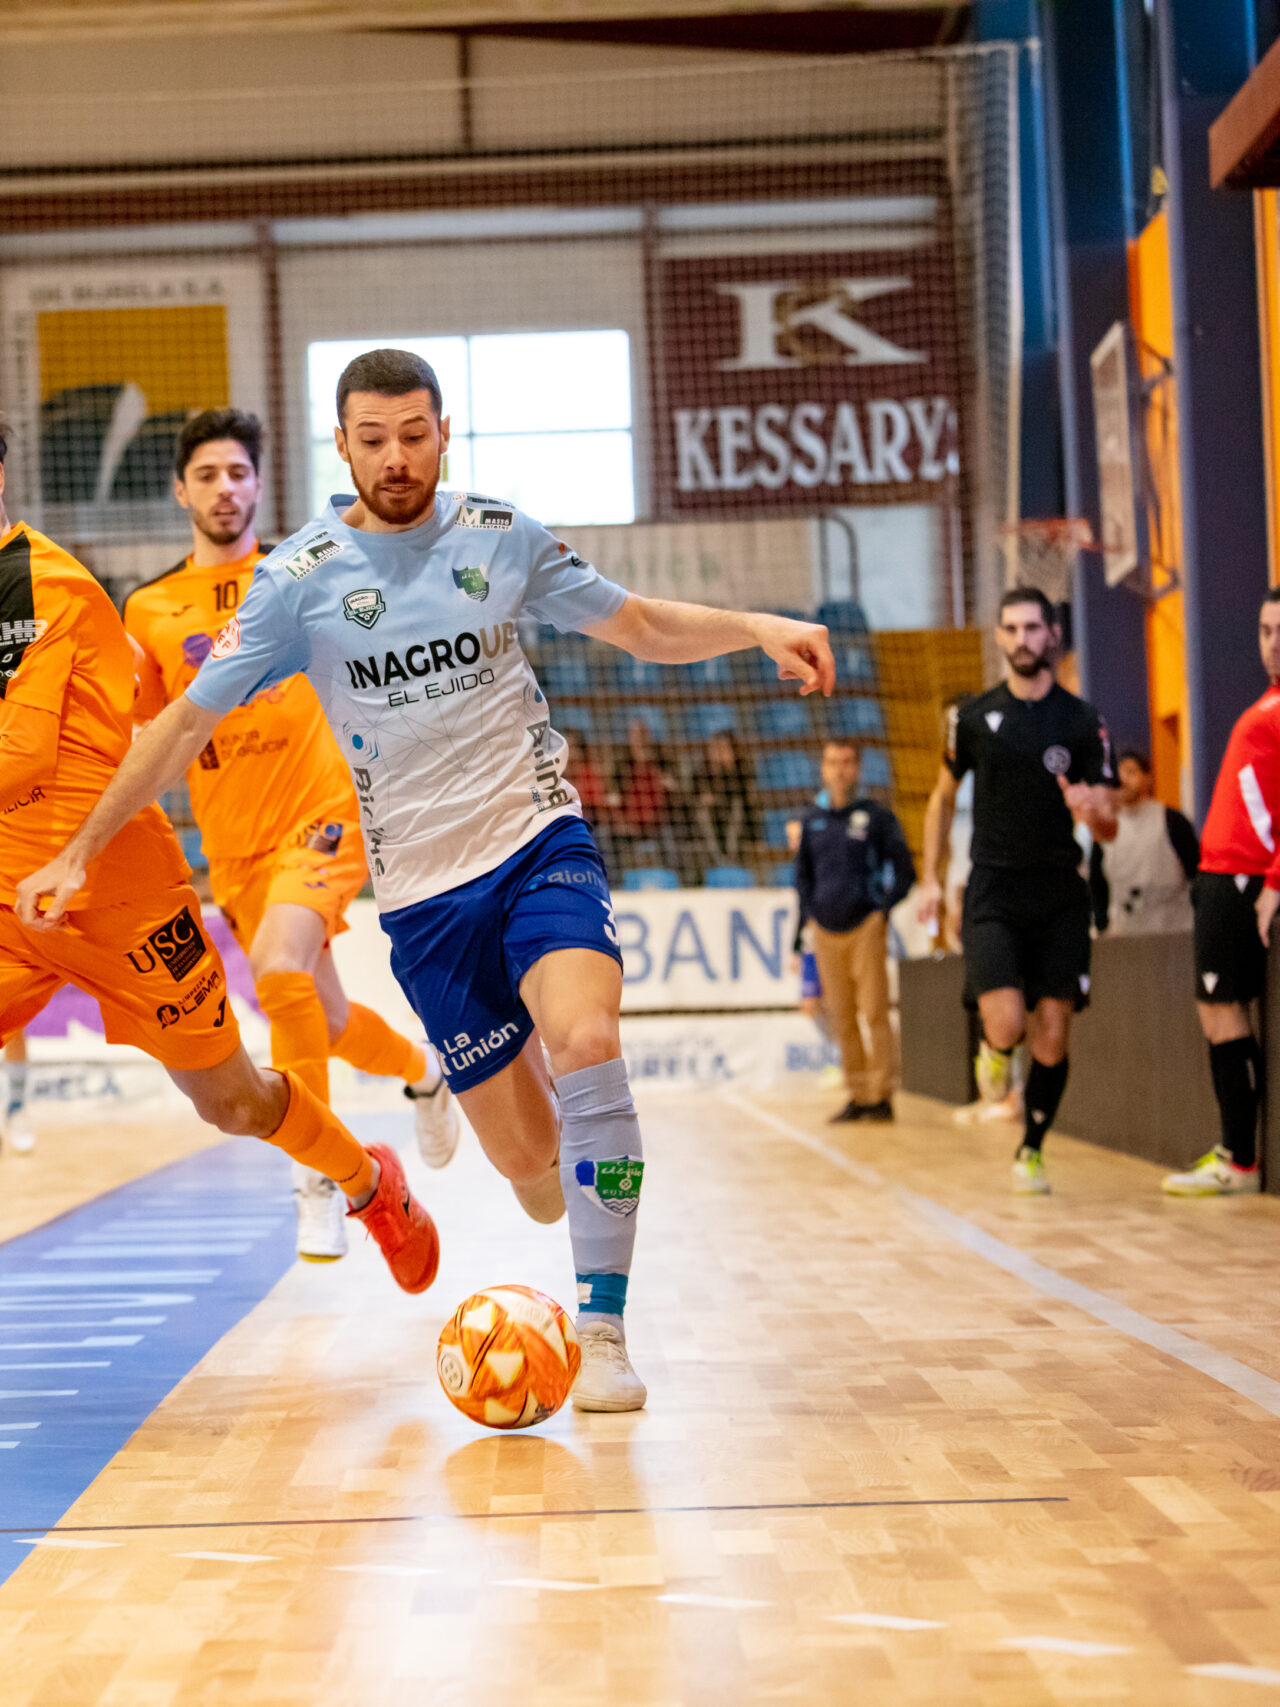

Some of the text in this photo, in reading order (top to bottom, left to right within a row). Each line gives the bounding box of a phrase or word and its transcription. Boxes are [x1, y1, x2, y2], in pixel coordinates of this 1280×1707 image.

[212, 580, 239, 612] 10
[345, 620, 516, 690] INAGROUP
[388, 668, 496, 707] EL EJIDO
[123, 914, 194, 974] USC
[443, 1032, 471, 1054] La
[451, 1023, 519, 1071] unión
